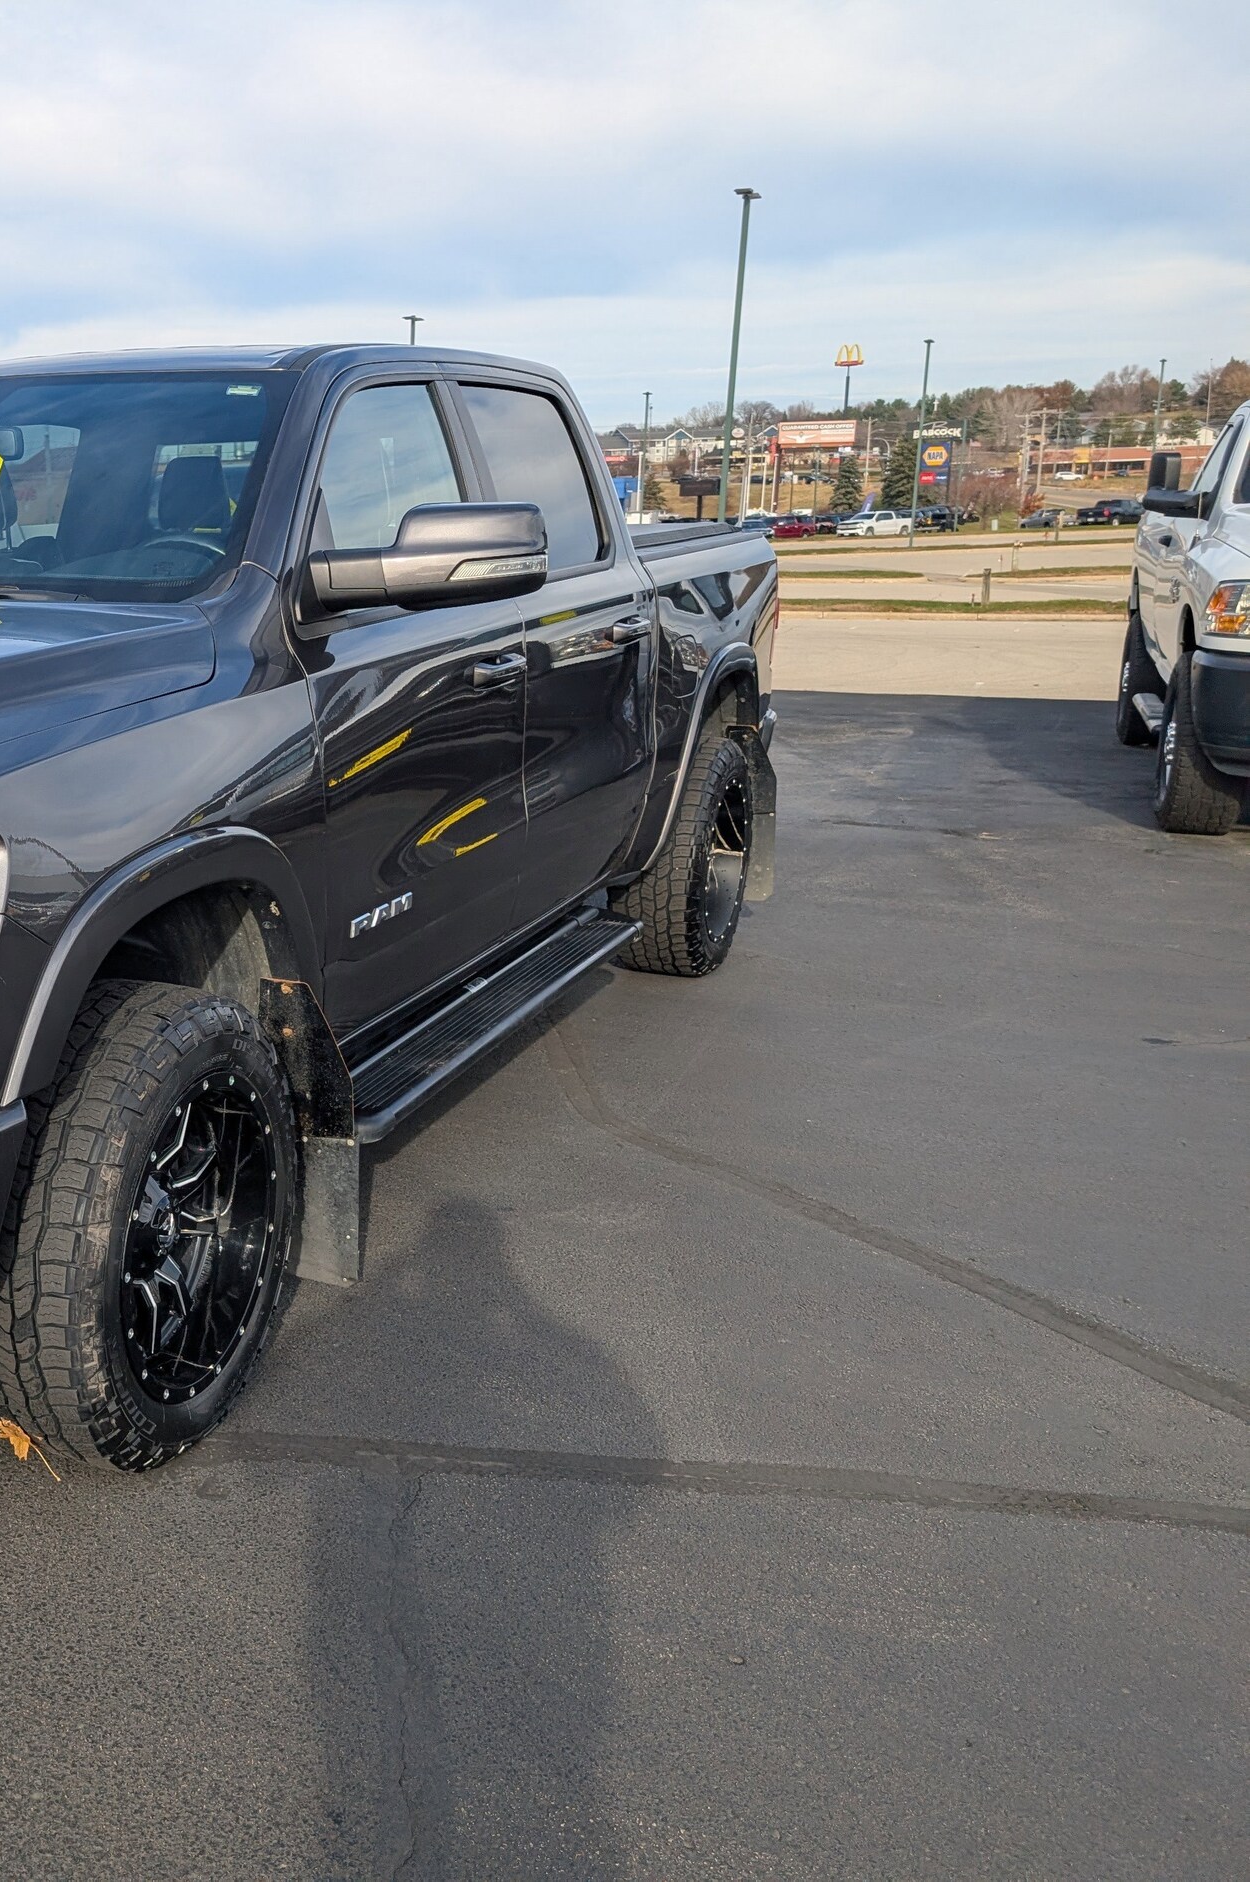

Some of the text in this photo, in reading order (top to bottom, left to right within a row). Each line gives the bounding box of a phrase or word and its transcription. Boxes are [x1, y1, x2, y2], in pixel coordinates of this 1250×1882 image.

[913, 428, 962, 439] BABCOCK
[927, 451, 943, 460] NAPA
[350, 891, 413, 939] RAM
